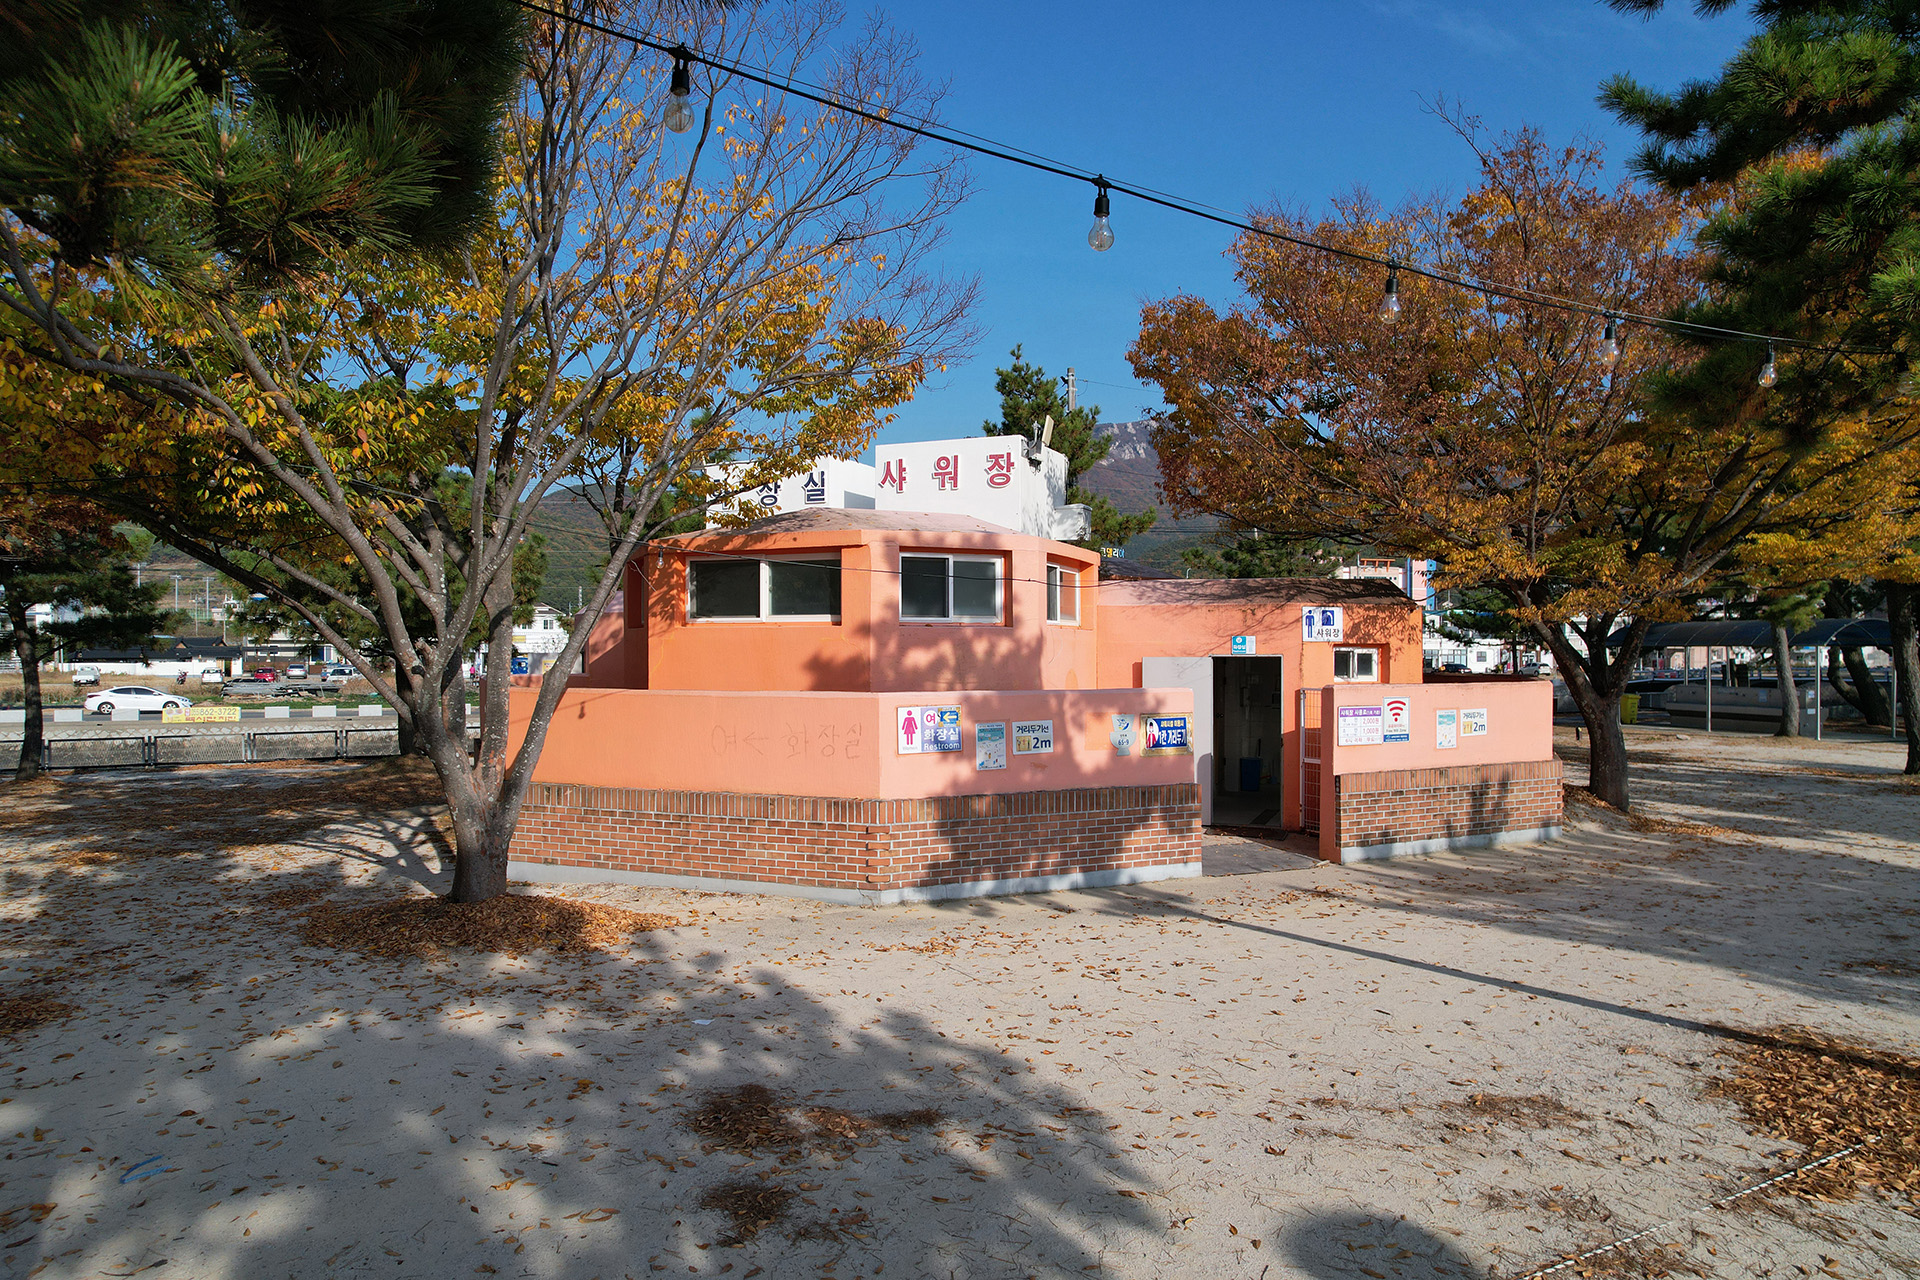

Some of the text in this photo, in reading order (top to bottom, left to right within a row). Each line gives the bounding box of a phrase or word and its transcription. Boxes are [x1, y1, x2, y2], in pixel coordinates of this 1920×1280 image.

[879, 451, 1015, 492] 샤워장
[1316, 628, 1340, 638] 샤워장
[925, 712, 936, 725] 여
[1016, 723, 1049, 734] 거리두기선
[1473, 721, 1486, 732] 2m
[923, 727, 959, 741] 화장실
[1167, 729, 1187, 745] 거리두기
[923, 743, 960, 751] Restroom
[1032, 736, 1051, 749] 2m
